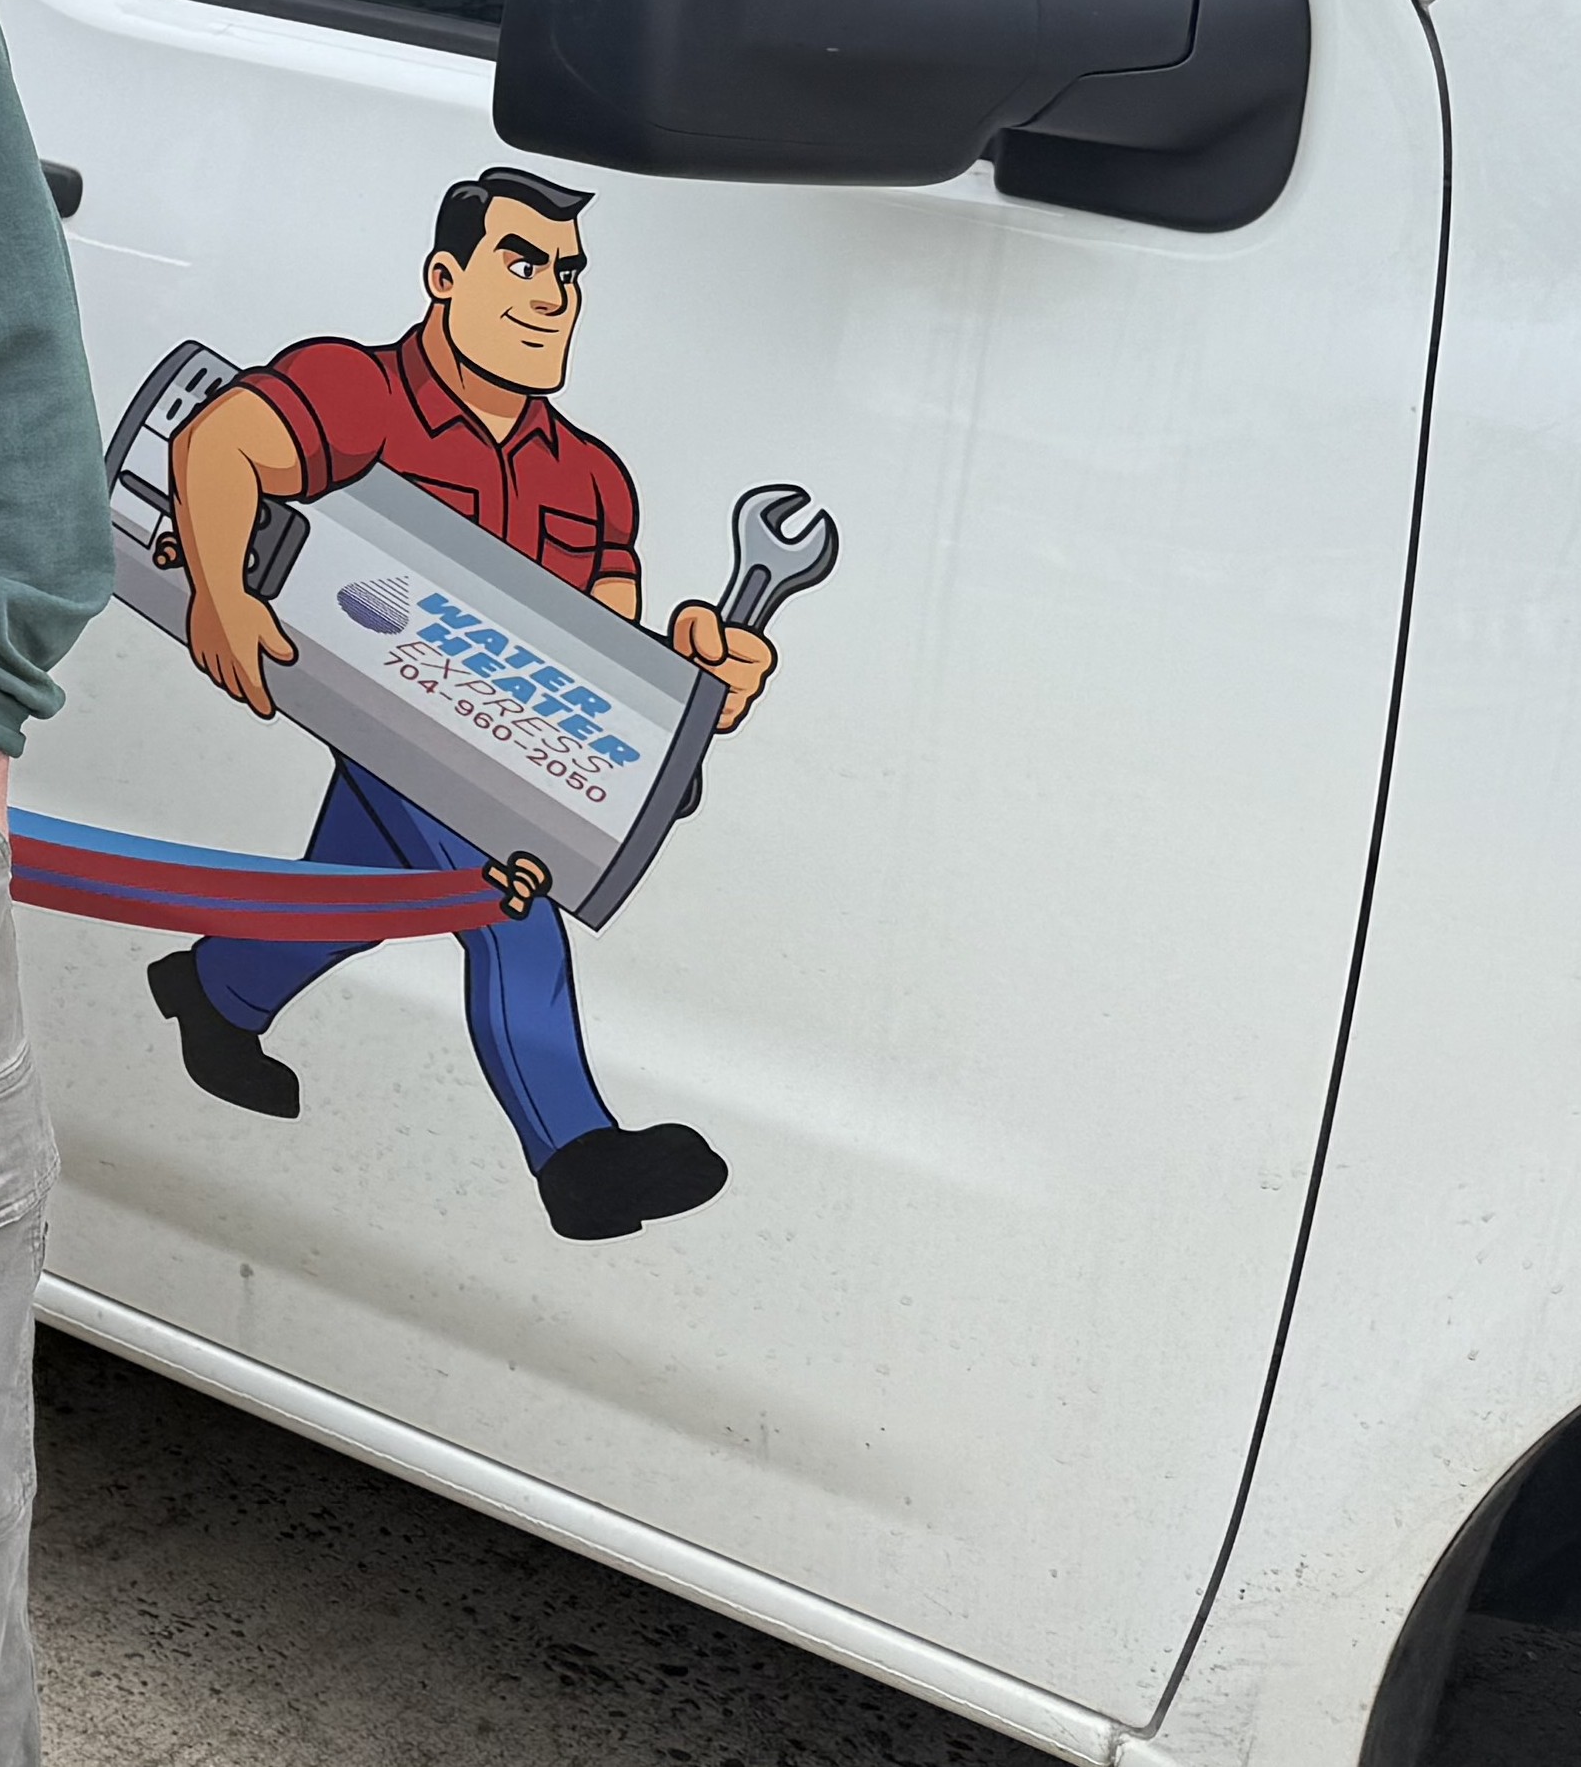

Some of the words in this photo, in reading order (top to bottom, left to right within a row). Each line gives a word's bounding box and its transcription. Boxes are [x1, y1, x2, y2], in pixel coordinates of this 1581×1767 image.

[396, 641, 613, 773] EXPRESS
[417, 593, 612, 718] WATER
[417, 622, 640, 767] HEATER
[383, 651, 607, 802] 704-960-2050
